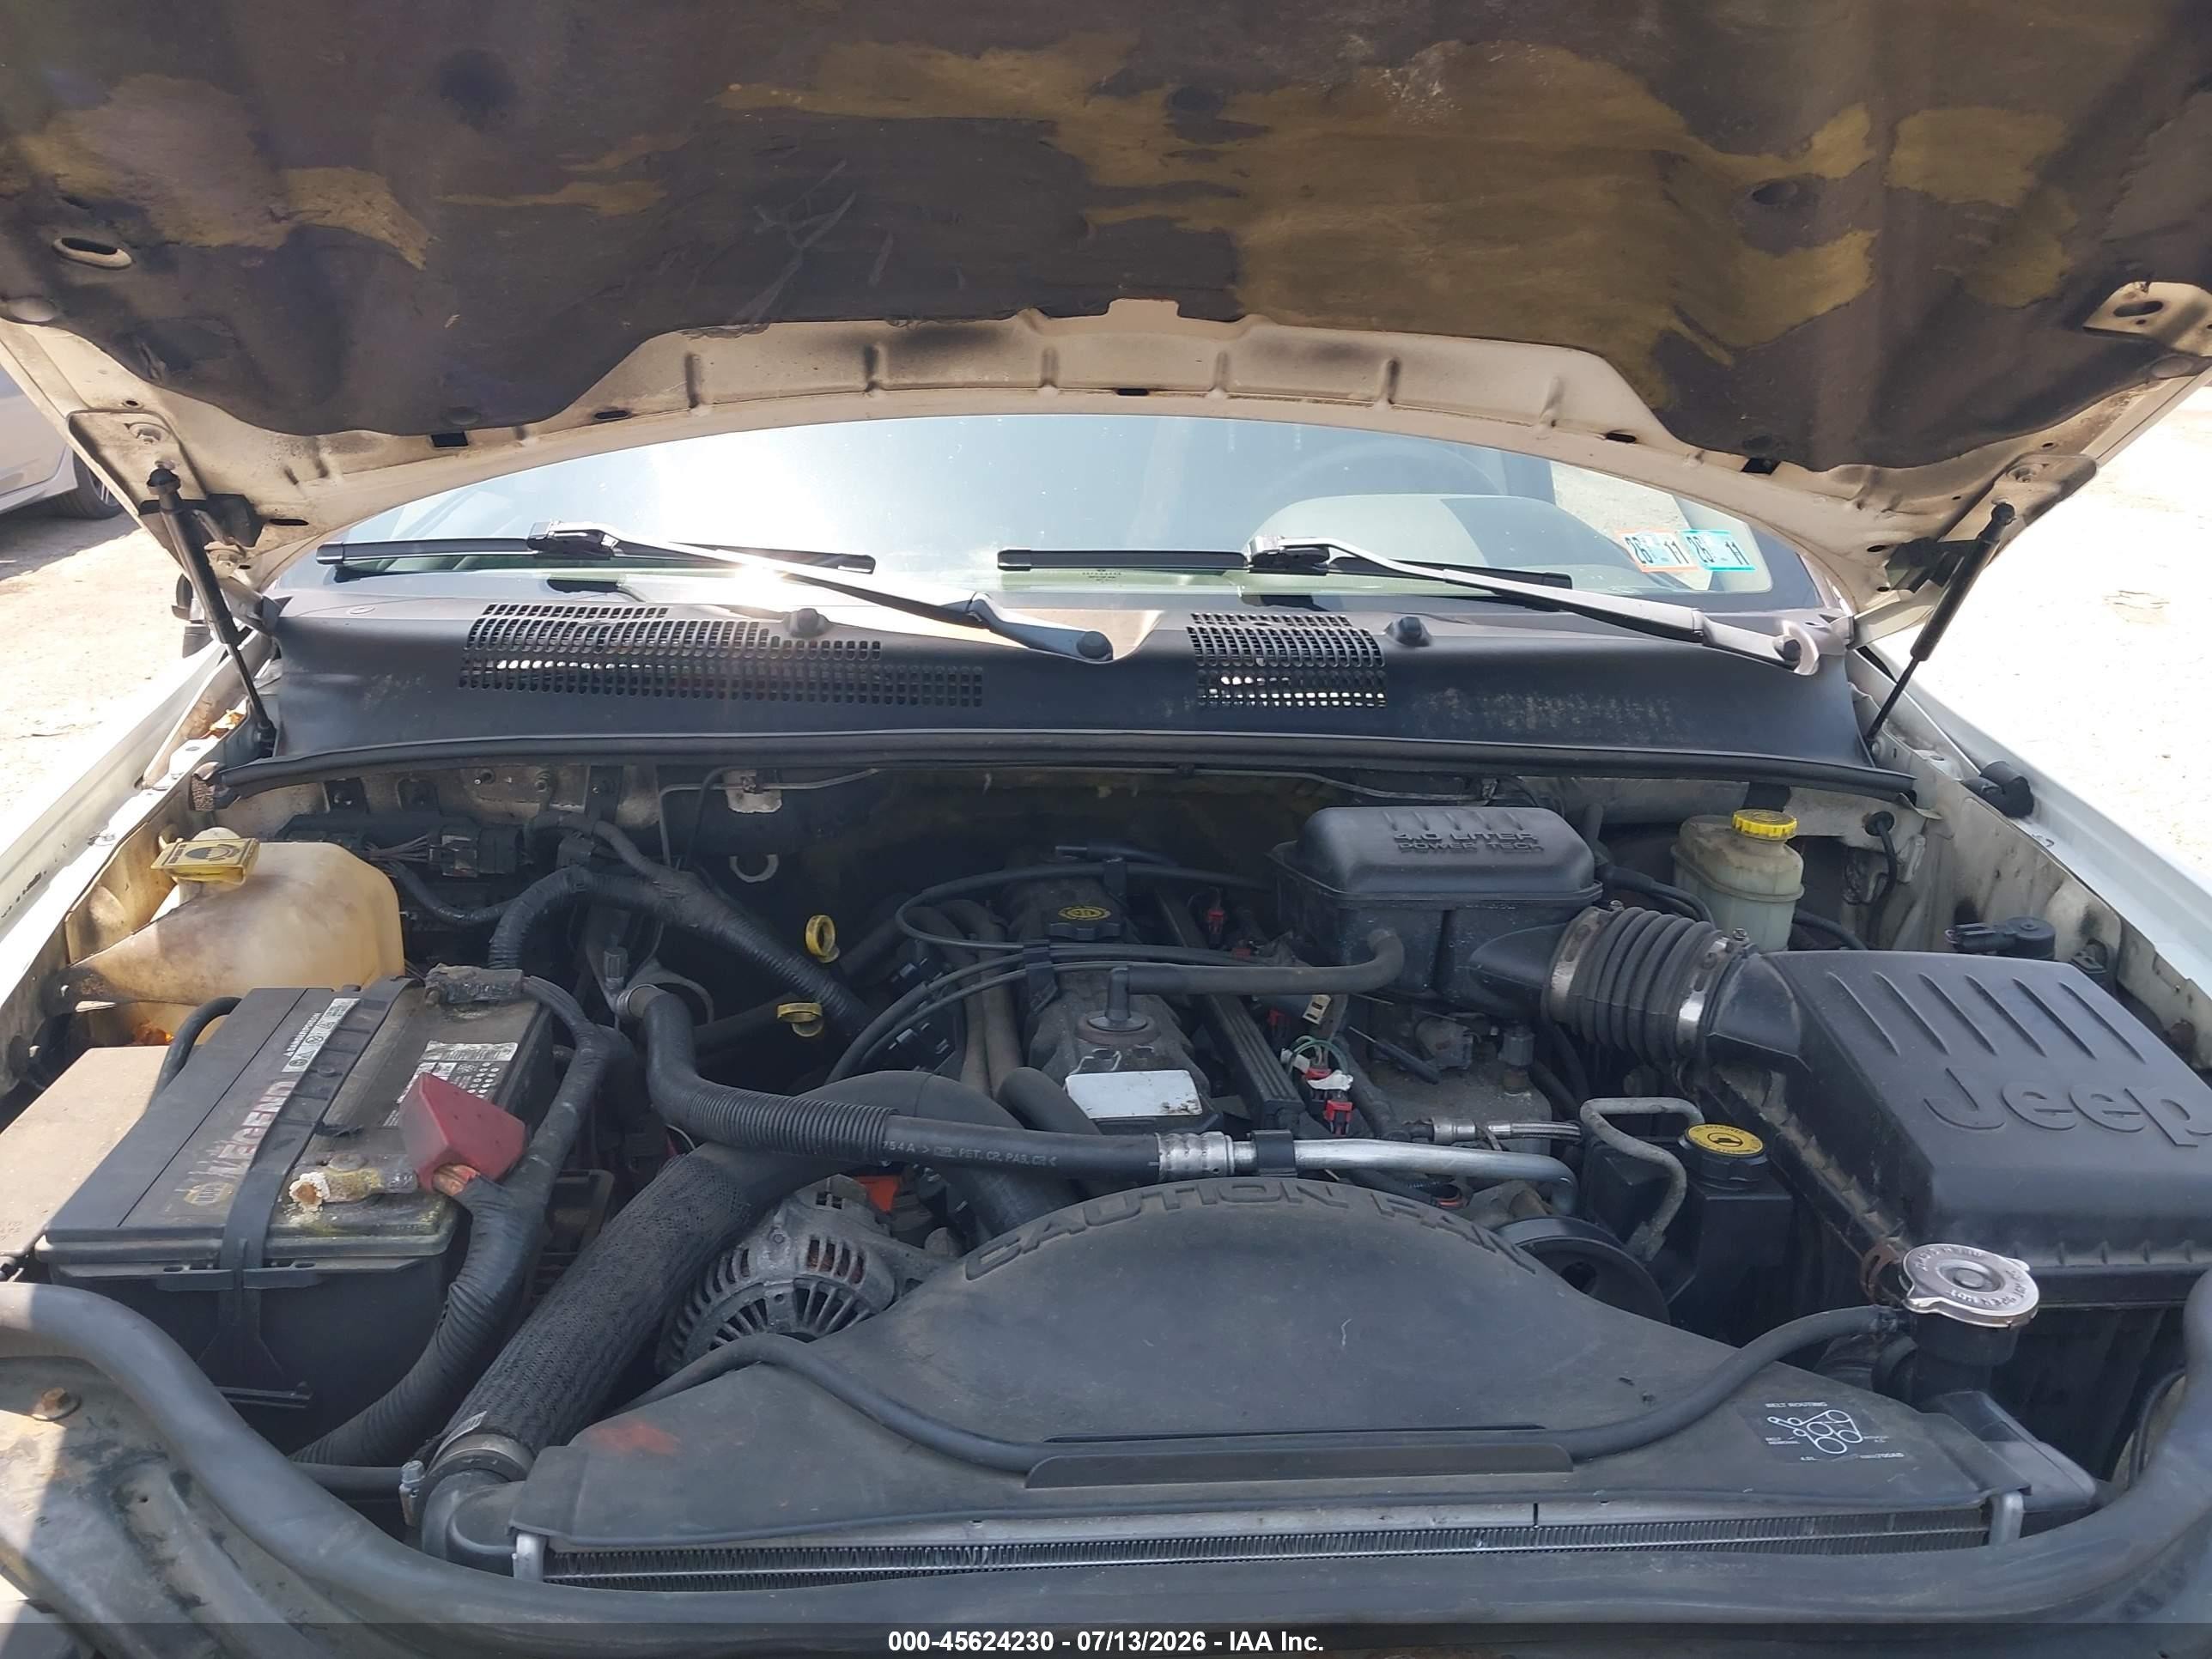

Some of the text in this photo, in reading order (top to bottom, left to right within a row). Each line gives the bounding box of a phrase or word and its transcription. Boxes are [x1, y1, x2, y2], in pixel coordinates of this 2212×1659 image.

[1625, 536, 1690, 564] 26 11
[1725, 541, 1750, 565] 11
[1394, 831, 1537, 843] 4.0 LITER
[1398, 842, 1546, 853] POWER TECH
[1923, 1066, 2212, 1147] Jeep
[963, 1179, 1538, 1282] CAUTION FAN
